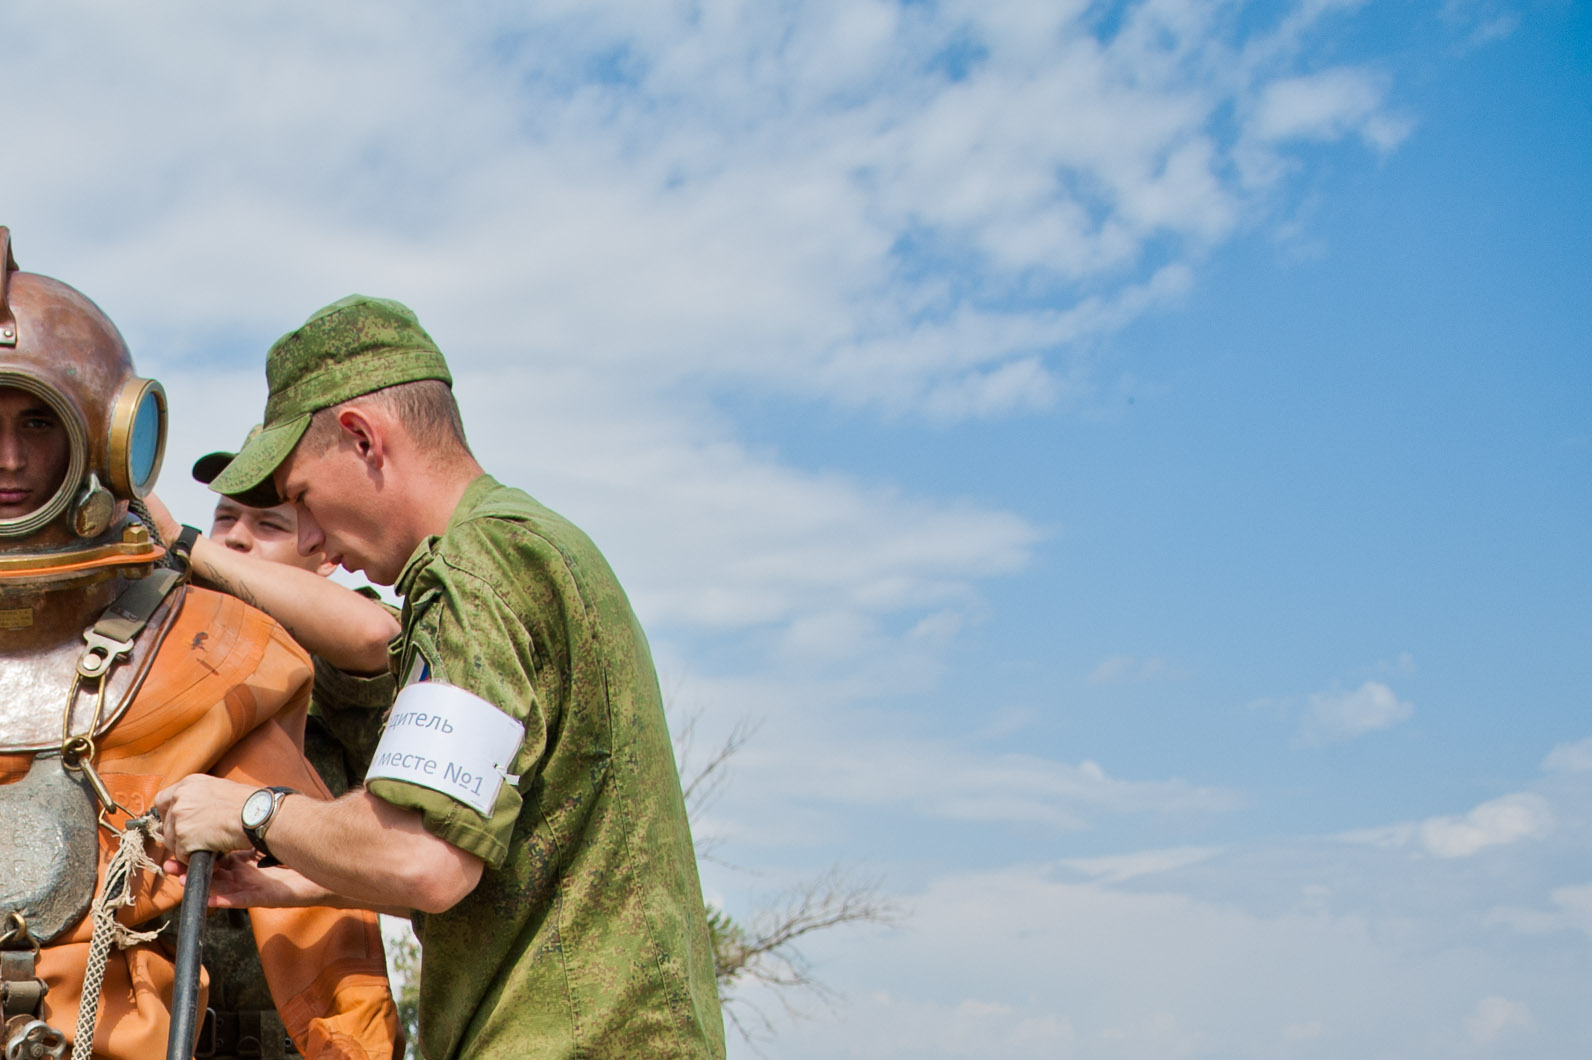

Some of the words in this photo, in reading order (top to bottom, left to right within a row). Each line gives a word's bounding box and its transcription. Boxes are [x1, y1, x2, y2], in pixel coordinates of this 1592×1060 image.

[388, 711, 455, 735] дитель
[377, 751, 438, 775] месте
[442, 761, 485, 797] №1
